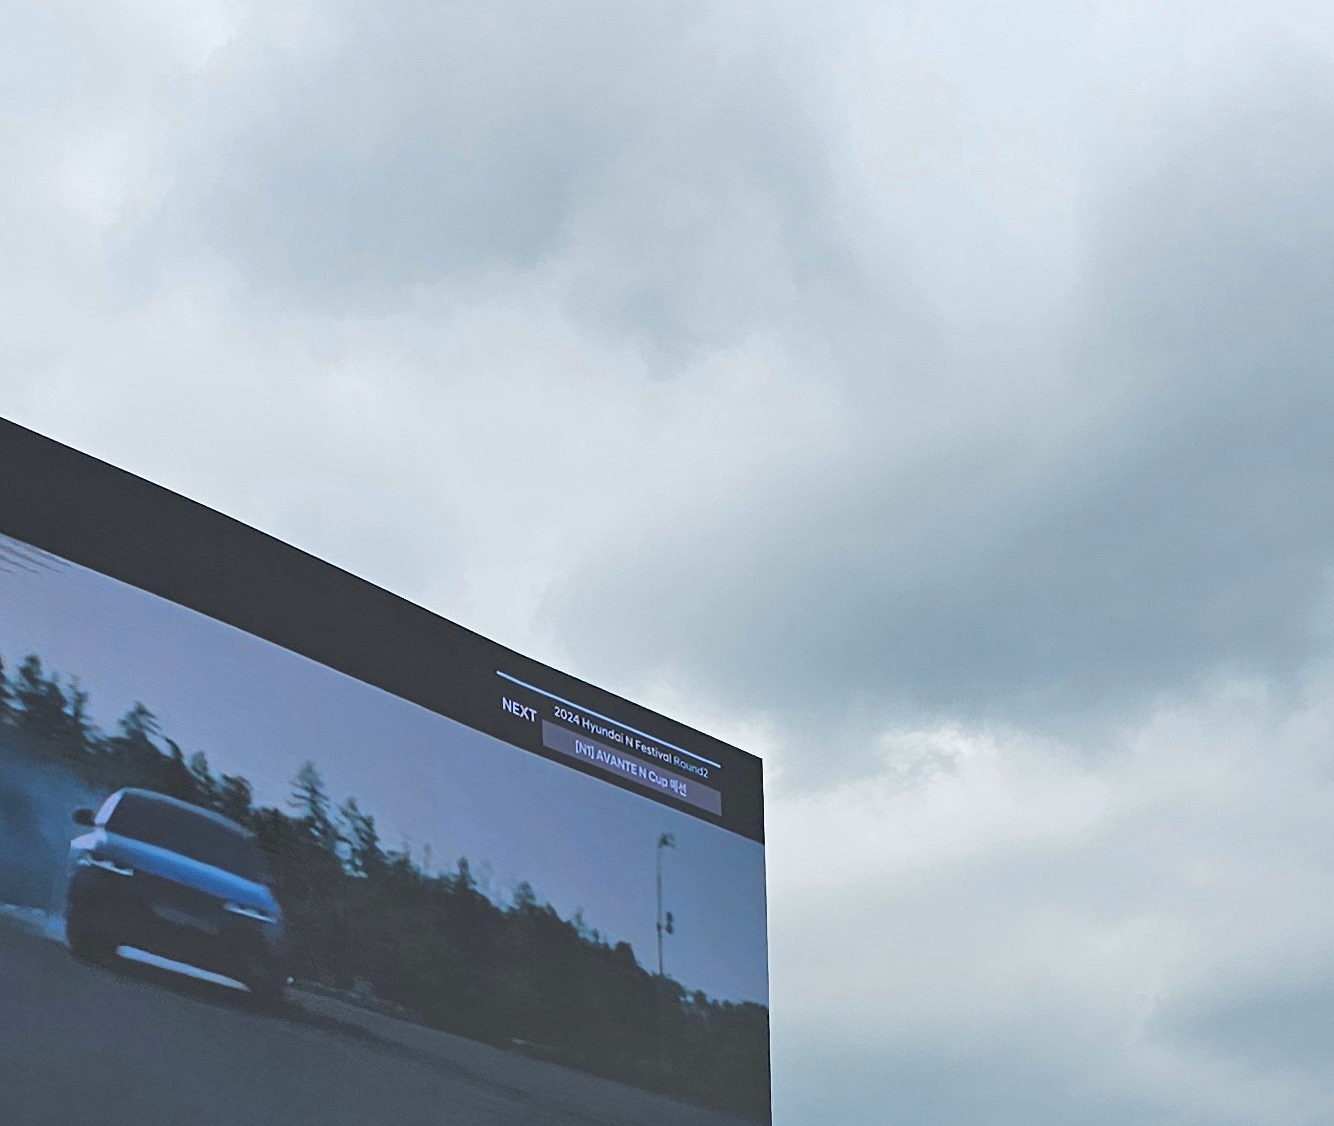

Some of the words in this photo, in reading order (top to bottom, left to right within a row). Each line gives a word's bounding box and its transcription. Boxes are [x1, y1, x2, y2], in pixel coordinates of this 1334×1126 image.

[502, 696, 537, 722] NEXT
[554, 706, 581, 726] 2024
[581, 717, 624, 744] Hyundai
[625, 735, 634, 748] N
[635, 739, 672, 763] Festival
[673, 755, 709, 779] Round2
[575, 739, 595, 760] [N1]
[595, 749, 638, 775] AVANTE
[638, 765, 647, 779] N
[648, 770, 668, 788] Cup
[669, 779, 687, 798] 예선
